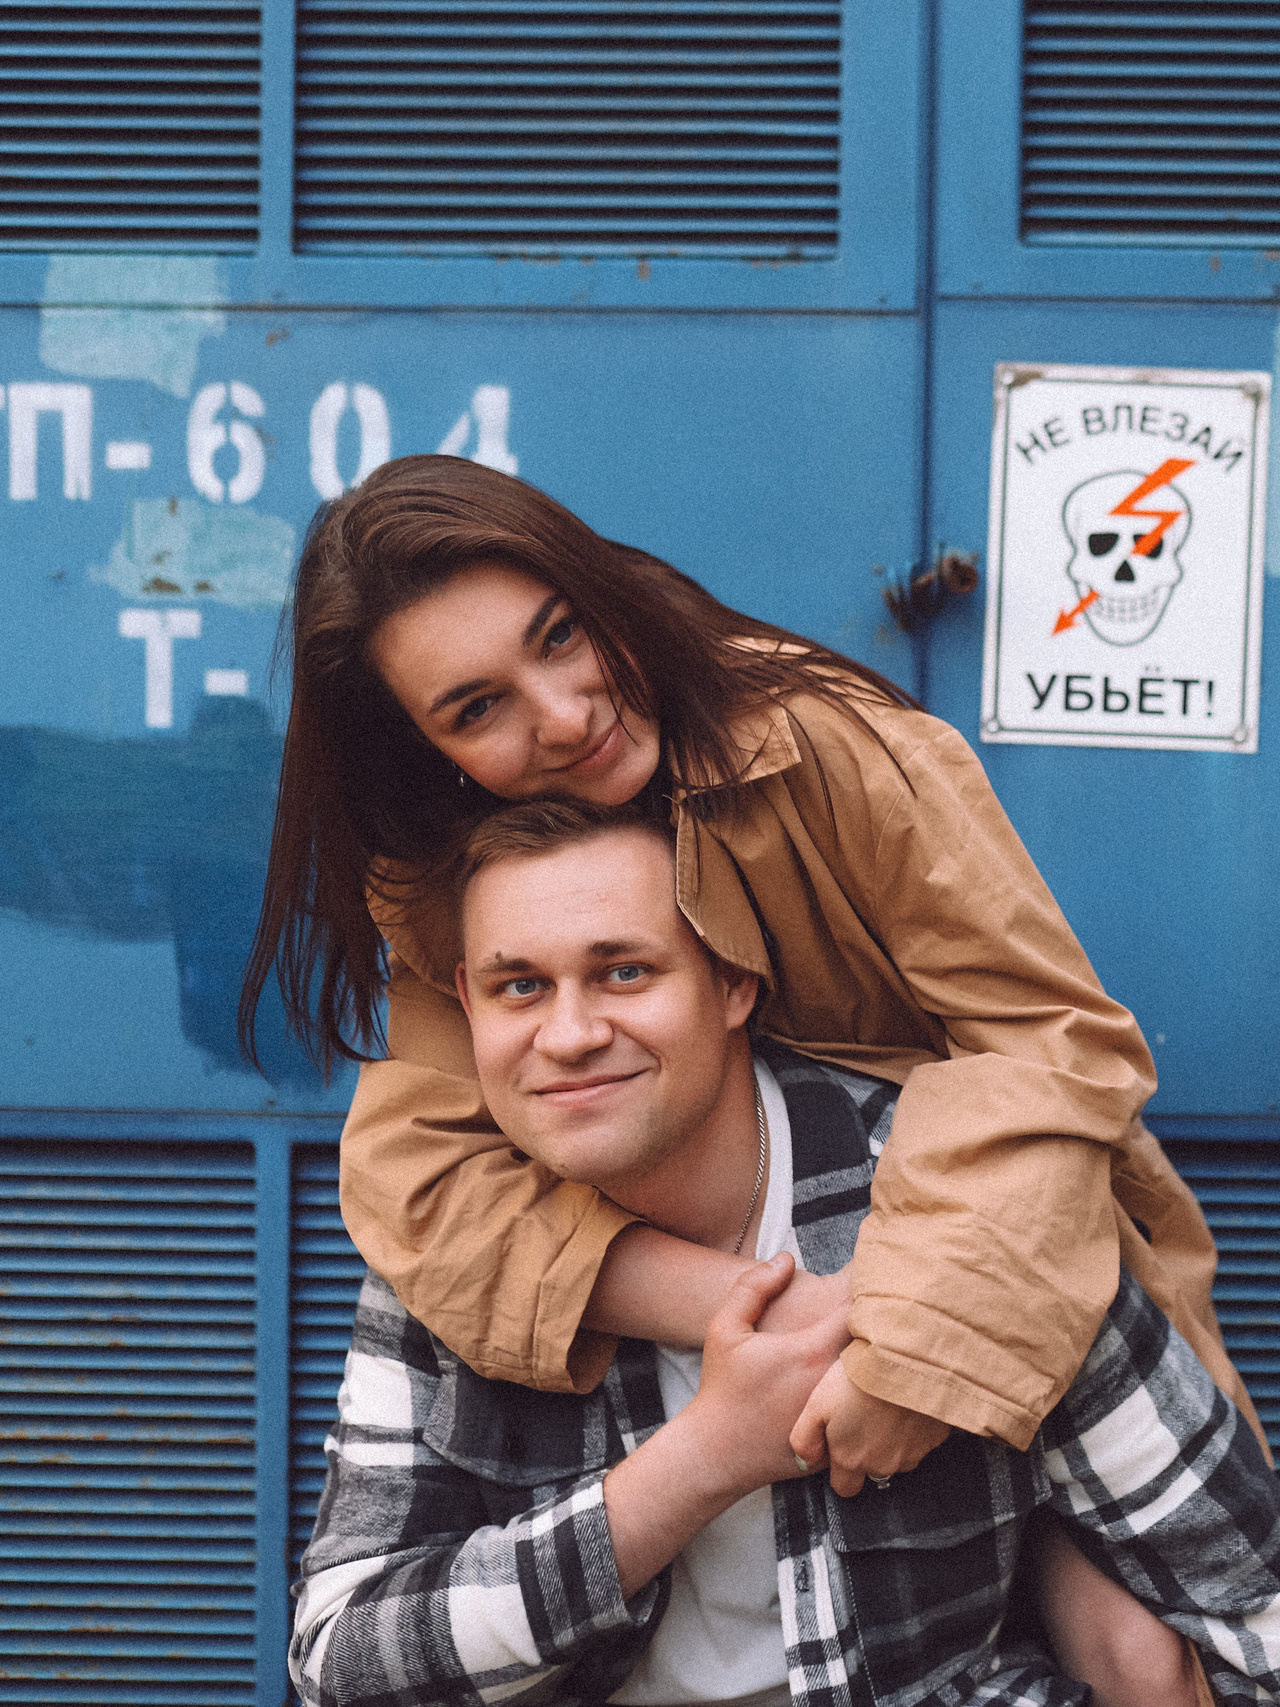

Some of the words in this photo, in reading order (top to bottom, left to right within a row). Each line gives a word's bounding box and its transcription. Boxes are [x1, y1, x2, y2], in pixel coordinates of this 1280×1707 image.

[0, 381, 519, 502] П-604
[1014, 415, 1071, 467] НЕ
[1026, 664, 1215, 718] УБЬЁТ!
